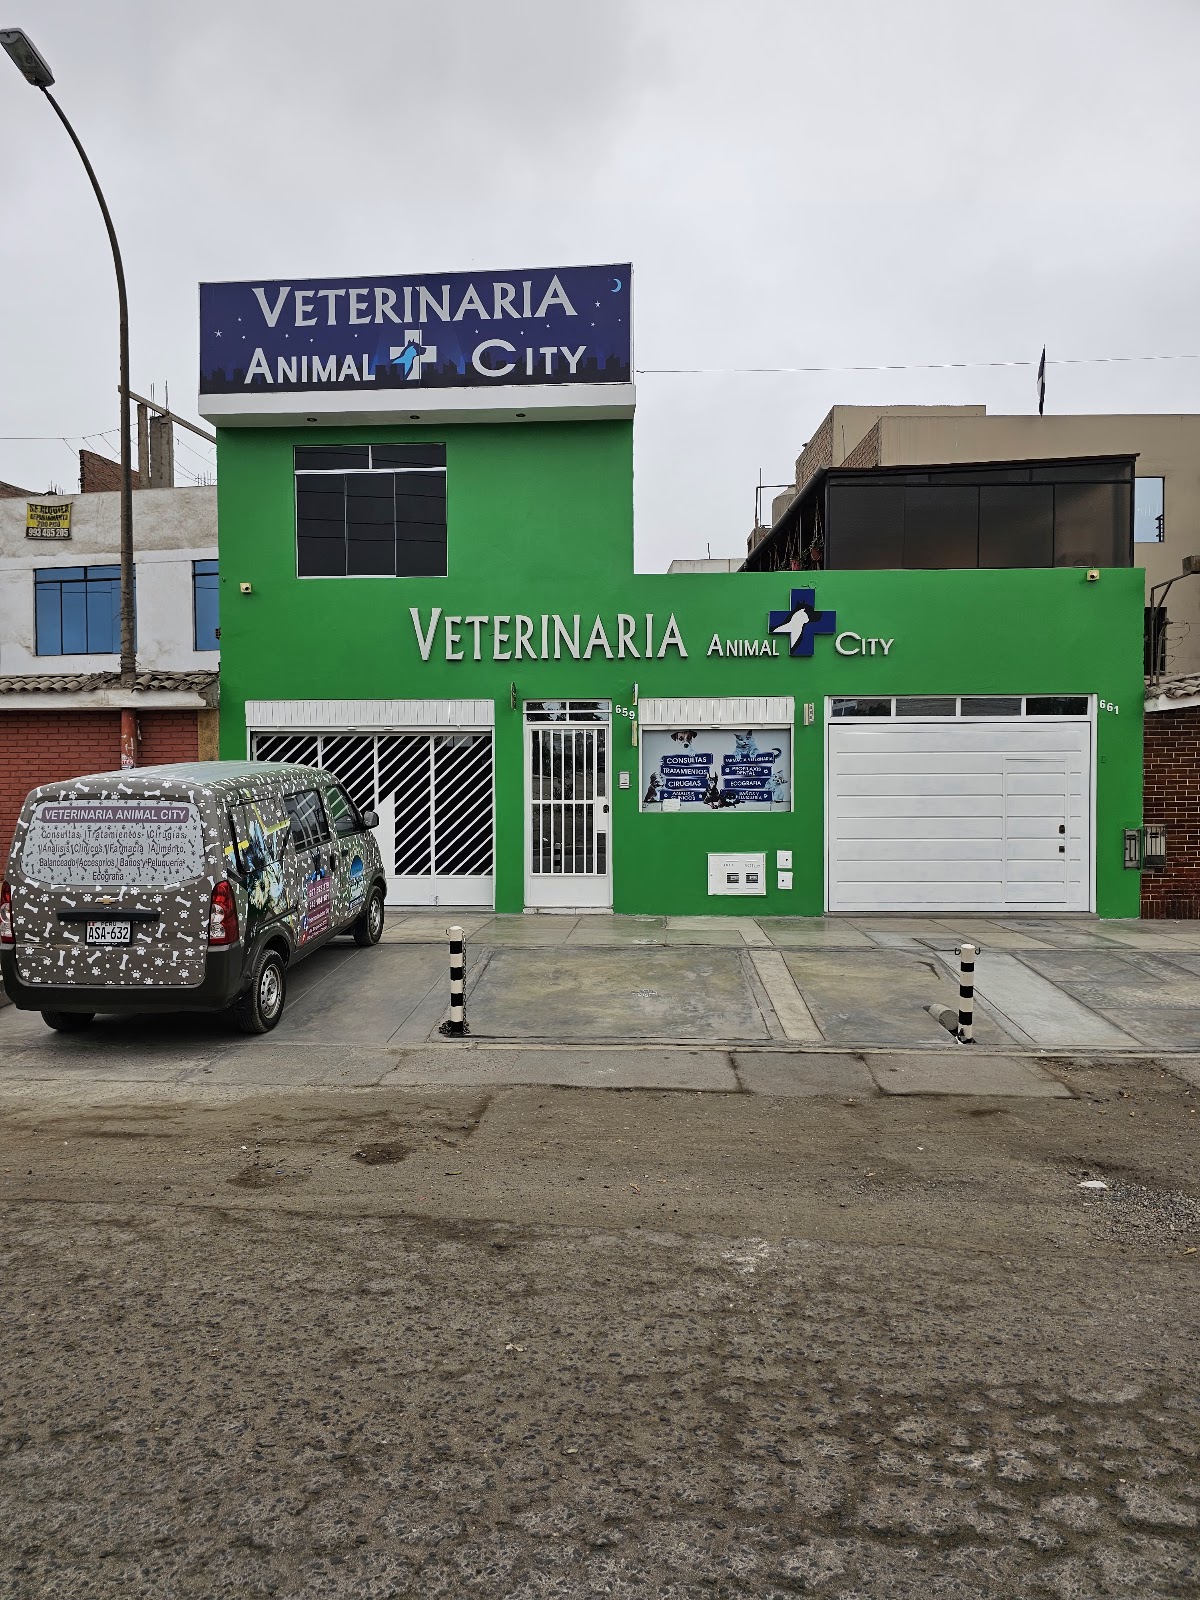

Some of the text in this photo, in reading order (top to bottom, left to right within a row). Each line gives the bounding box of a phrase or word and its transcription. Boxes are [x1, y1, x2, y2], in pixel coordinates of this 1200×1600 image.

[251, 274, 579, 328] VETERINARIA
[244, 338, 588, 385] ANIMAL CITY
[29, 504, 39, 513] SE
[28, 527, 69, 537] 993 485 205
[408, 607, 895, 662] VETERINARIA ANIMAL CITY
[615, 704, 636, 720] 659
[1099, 699, 1119, 715] 661
[666, 756, 707, 764] CONSULTAS
[662, 767, 708, 775] TRATAMIENTOS
[45, 809, 186, 820] VETERINARIA ANIMAL CITY
[41, 829, 80, 839] Consultas
[87, 829, 141, 839] Tratamientos
[40, 857, 75, 867] Balanceado
[79, 857, 115, 867] Accesorios
[88, 926, 129, 940] ASA-632
